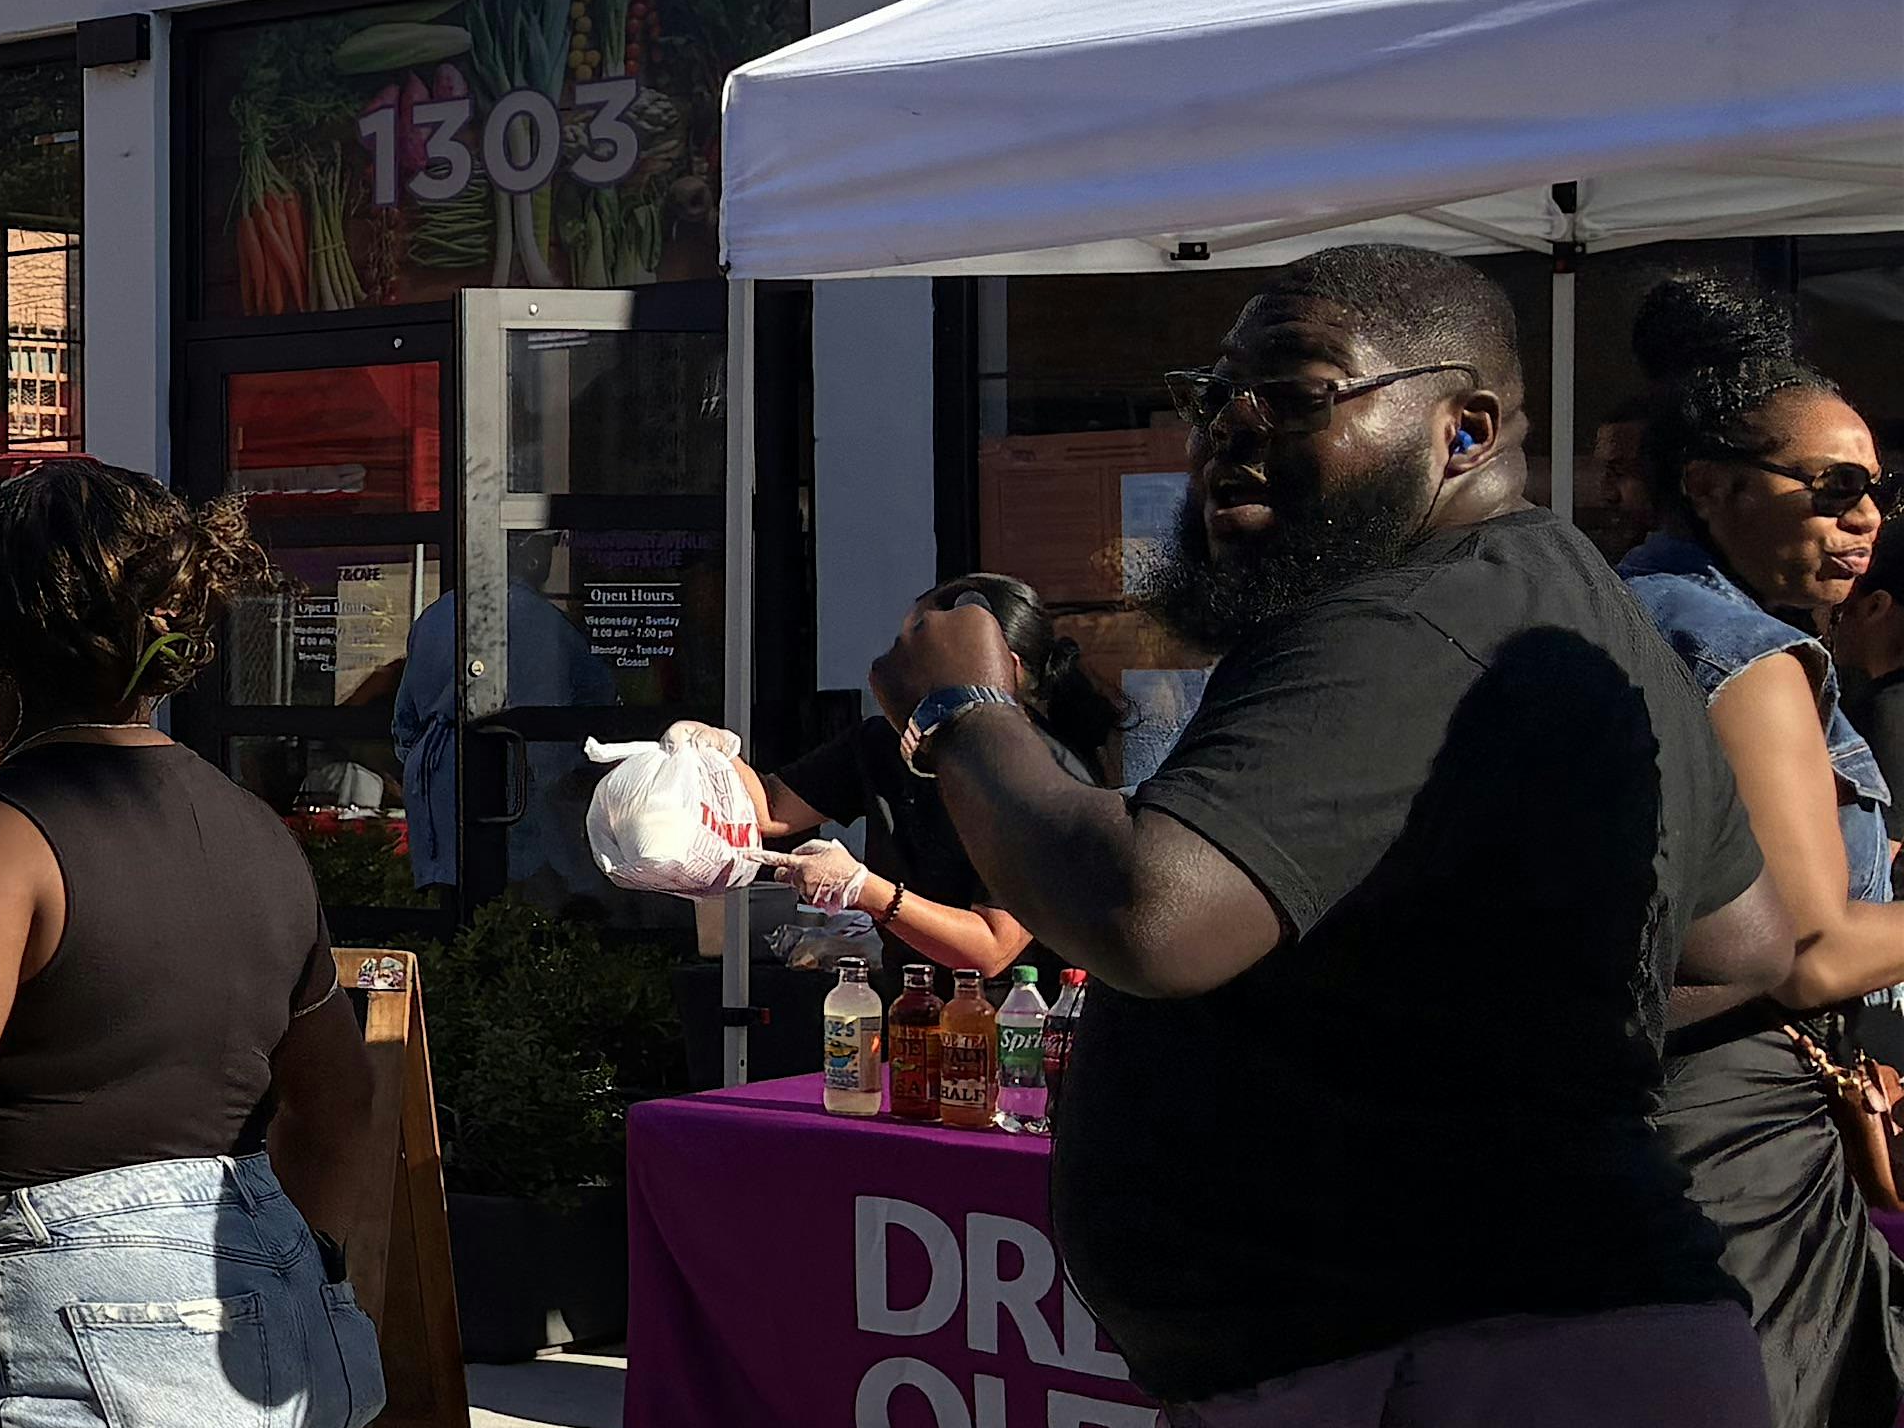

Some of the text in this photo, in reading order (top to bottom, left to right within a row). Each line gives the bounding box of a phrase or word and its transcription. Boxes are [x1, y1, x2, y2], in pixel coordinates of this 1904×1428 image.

[357, 77, 641, 207] 1303
[590, 588, 675, 604] Open Hours
